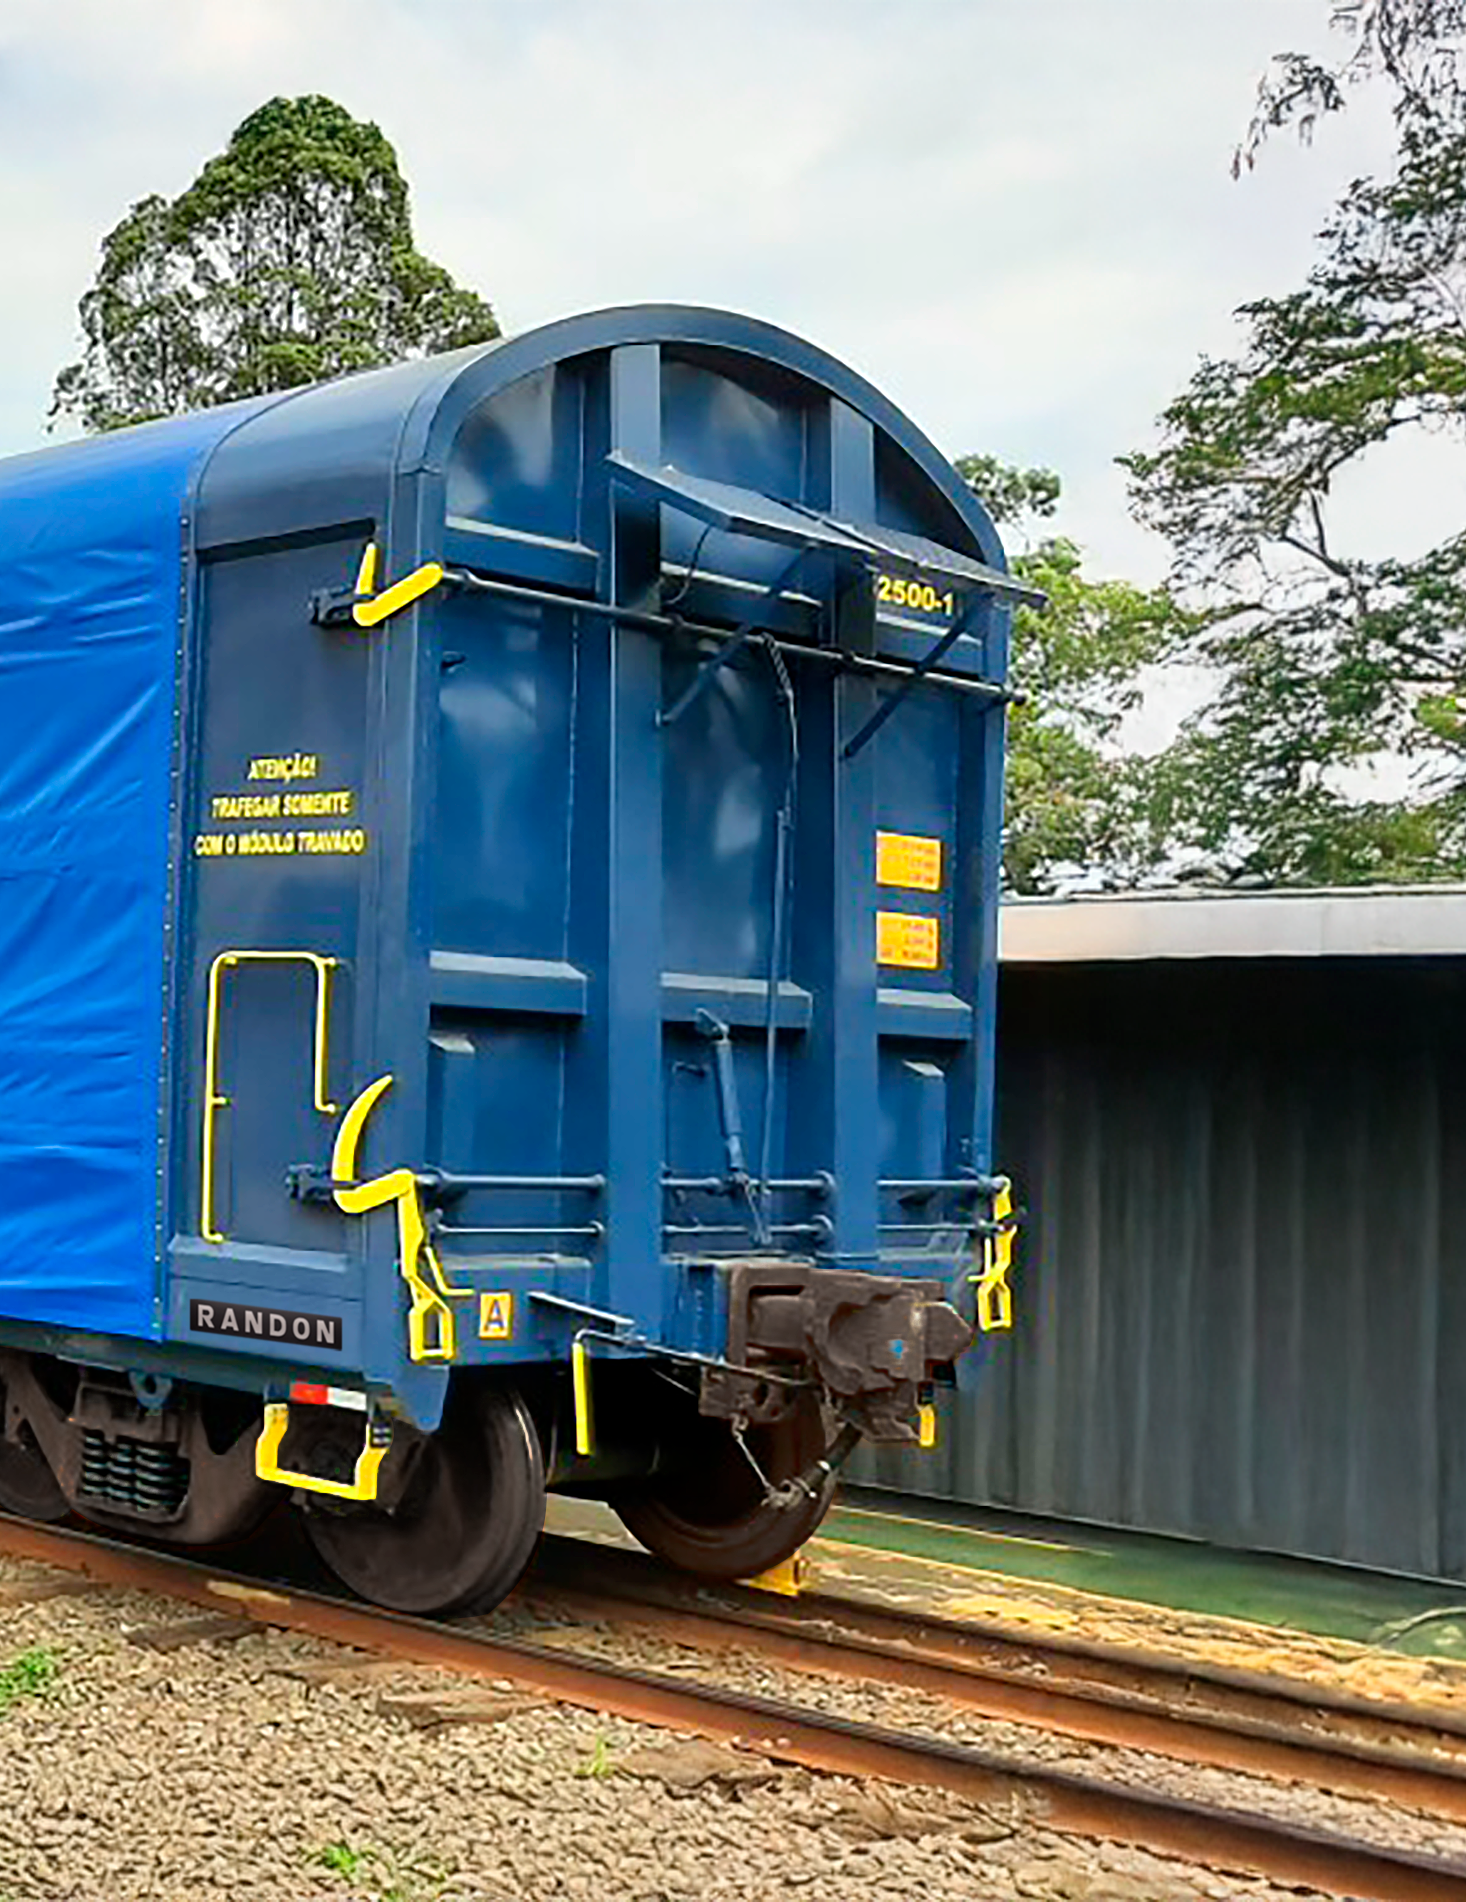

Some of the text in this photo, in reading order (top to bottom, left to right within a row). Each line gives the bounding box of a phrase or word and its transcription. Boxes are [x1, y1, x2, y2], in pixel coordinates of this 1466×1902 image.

[877, 574, 954, 617] 2500-1
[211, 791, 352, 819] TRAFEGAR SOMENTE
[194, 834, 223, 856] COM
[225, 833, 236, 854] O
[296, 828, 365, 853] TRAVADO
[197, 1304, 335, 1344] RANDON
[484, 1299, 505, 1331] A
